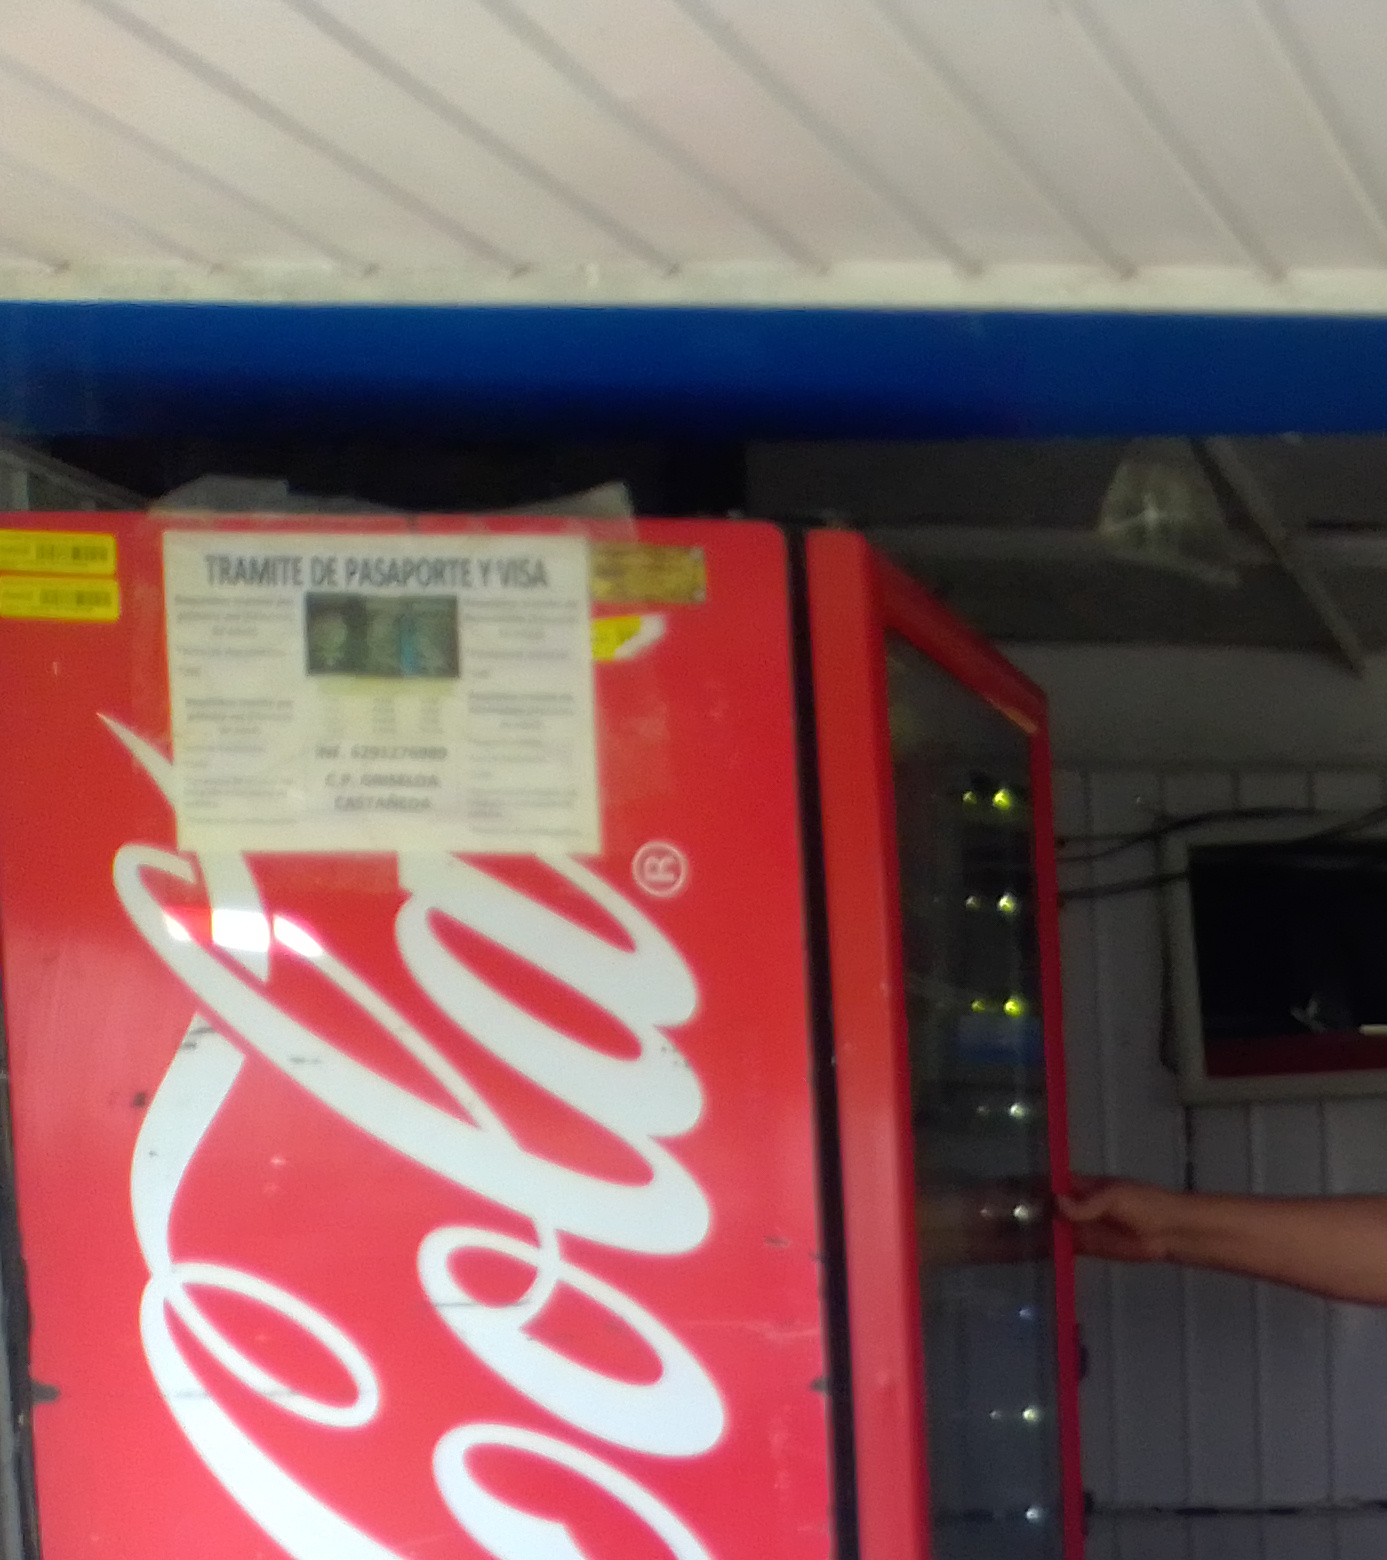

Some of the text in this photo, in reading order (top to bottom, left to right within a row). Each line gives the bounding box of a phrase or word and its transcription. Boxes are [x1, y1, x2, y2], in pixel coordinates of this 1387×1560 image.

[205, 555, 549, 589] TRAMITE DE PASAPORTE Y VISA
